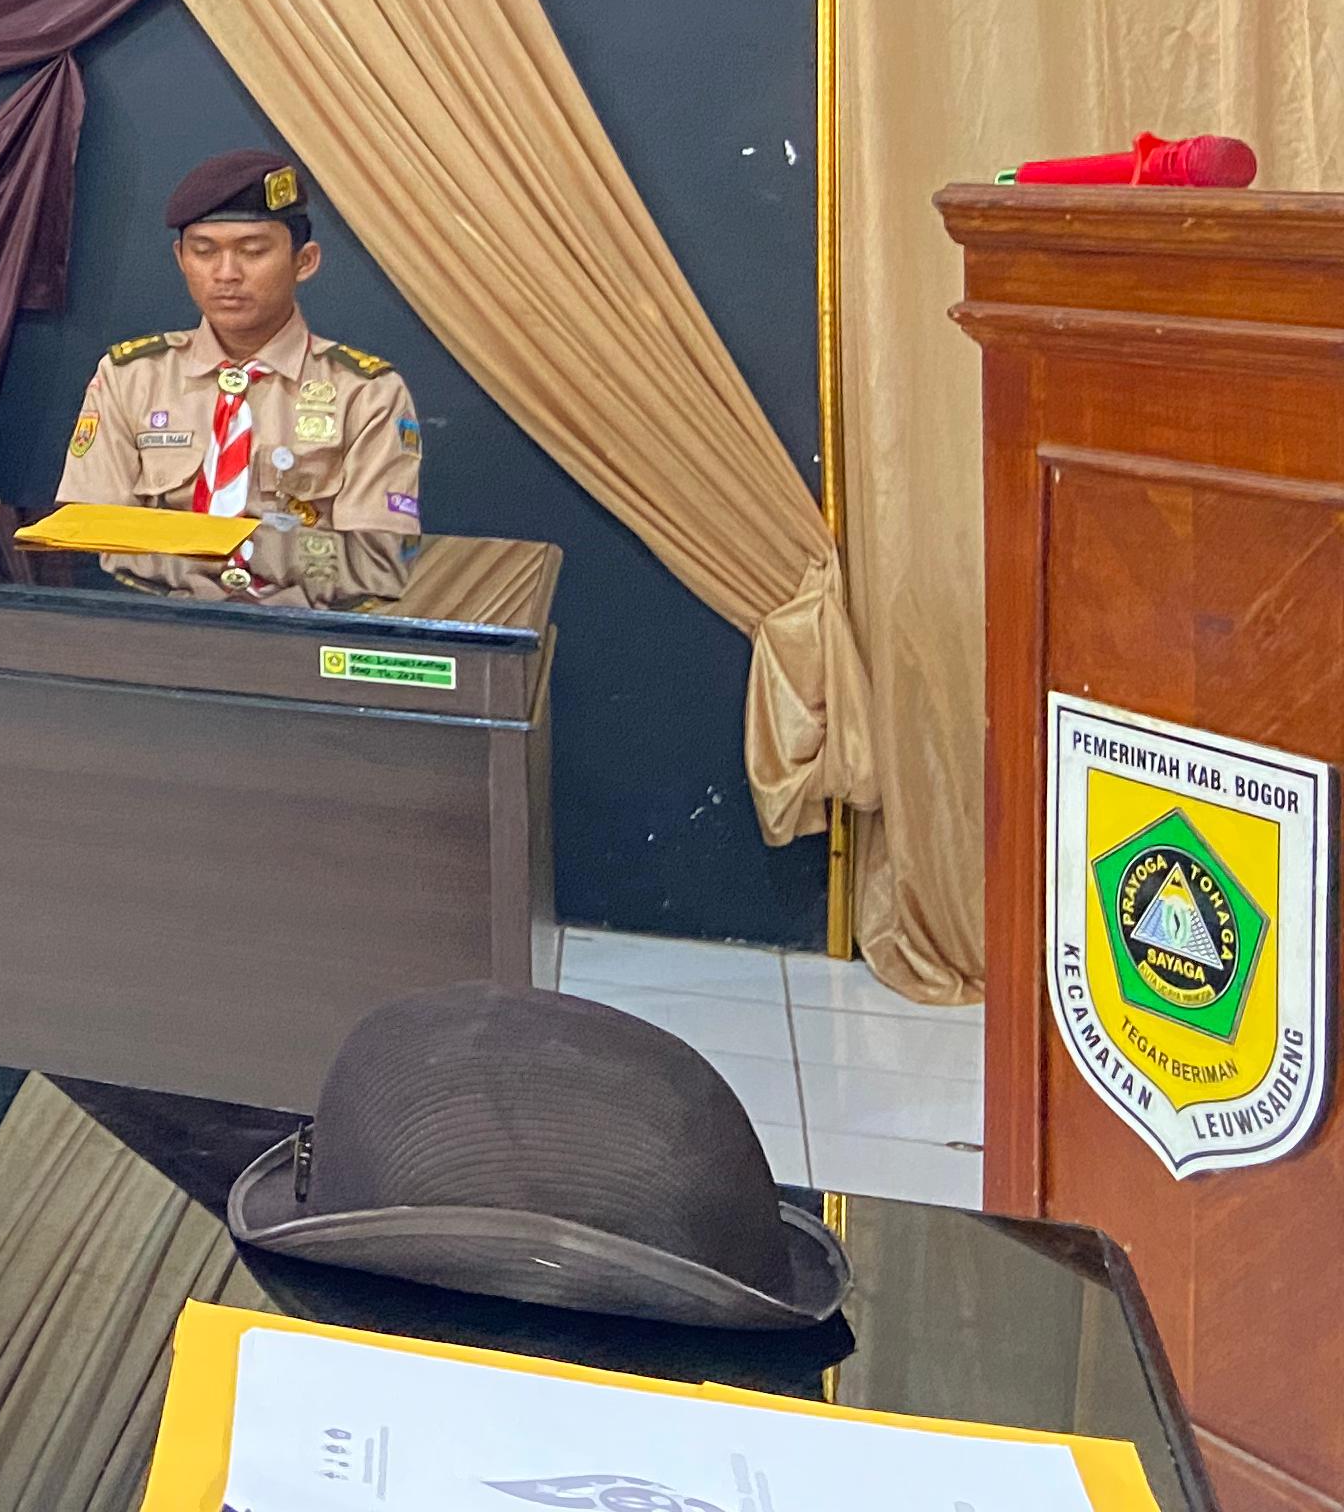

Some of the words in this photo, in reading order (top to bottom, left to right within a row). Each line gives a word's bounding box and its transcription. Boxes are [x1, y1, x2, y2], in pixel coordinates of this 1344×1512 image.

[1073, 730, 1180, 779] PEMERINTAH
[1187, 762, 1228, 793] KAB.
[1235, 776, 1300, 813] BOGOR
[1122, 854, 1169, 926] PRAYOGA
[1190, 864, 1235, 960] TOHAGA
[1146, 948, 1206, 984] SAYAGA
[1063, 943, 1153, 1111] KECAMATAN
[1192, 1027, 1304, 1139] LEUWISADENG
[1121, 1016, 1169, 1072] TEGAR
[1171, 1058, 1240, 1085] BERIMAN
